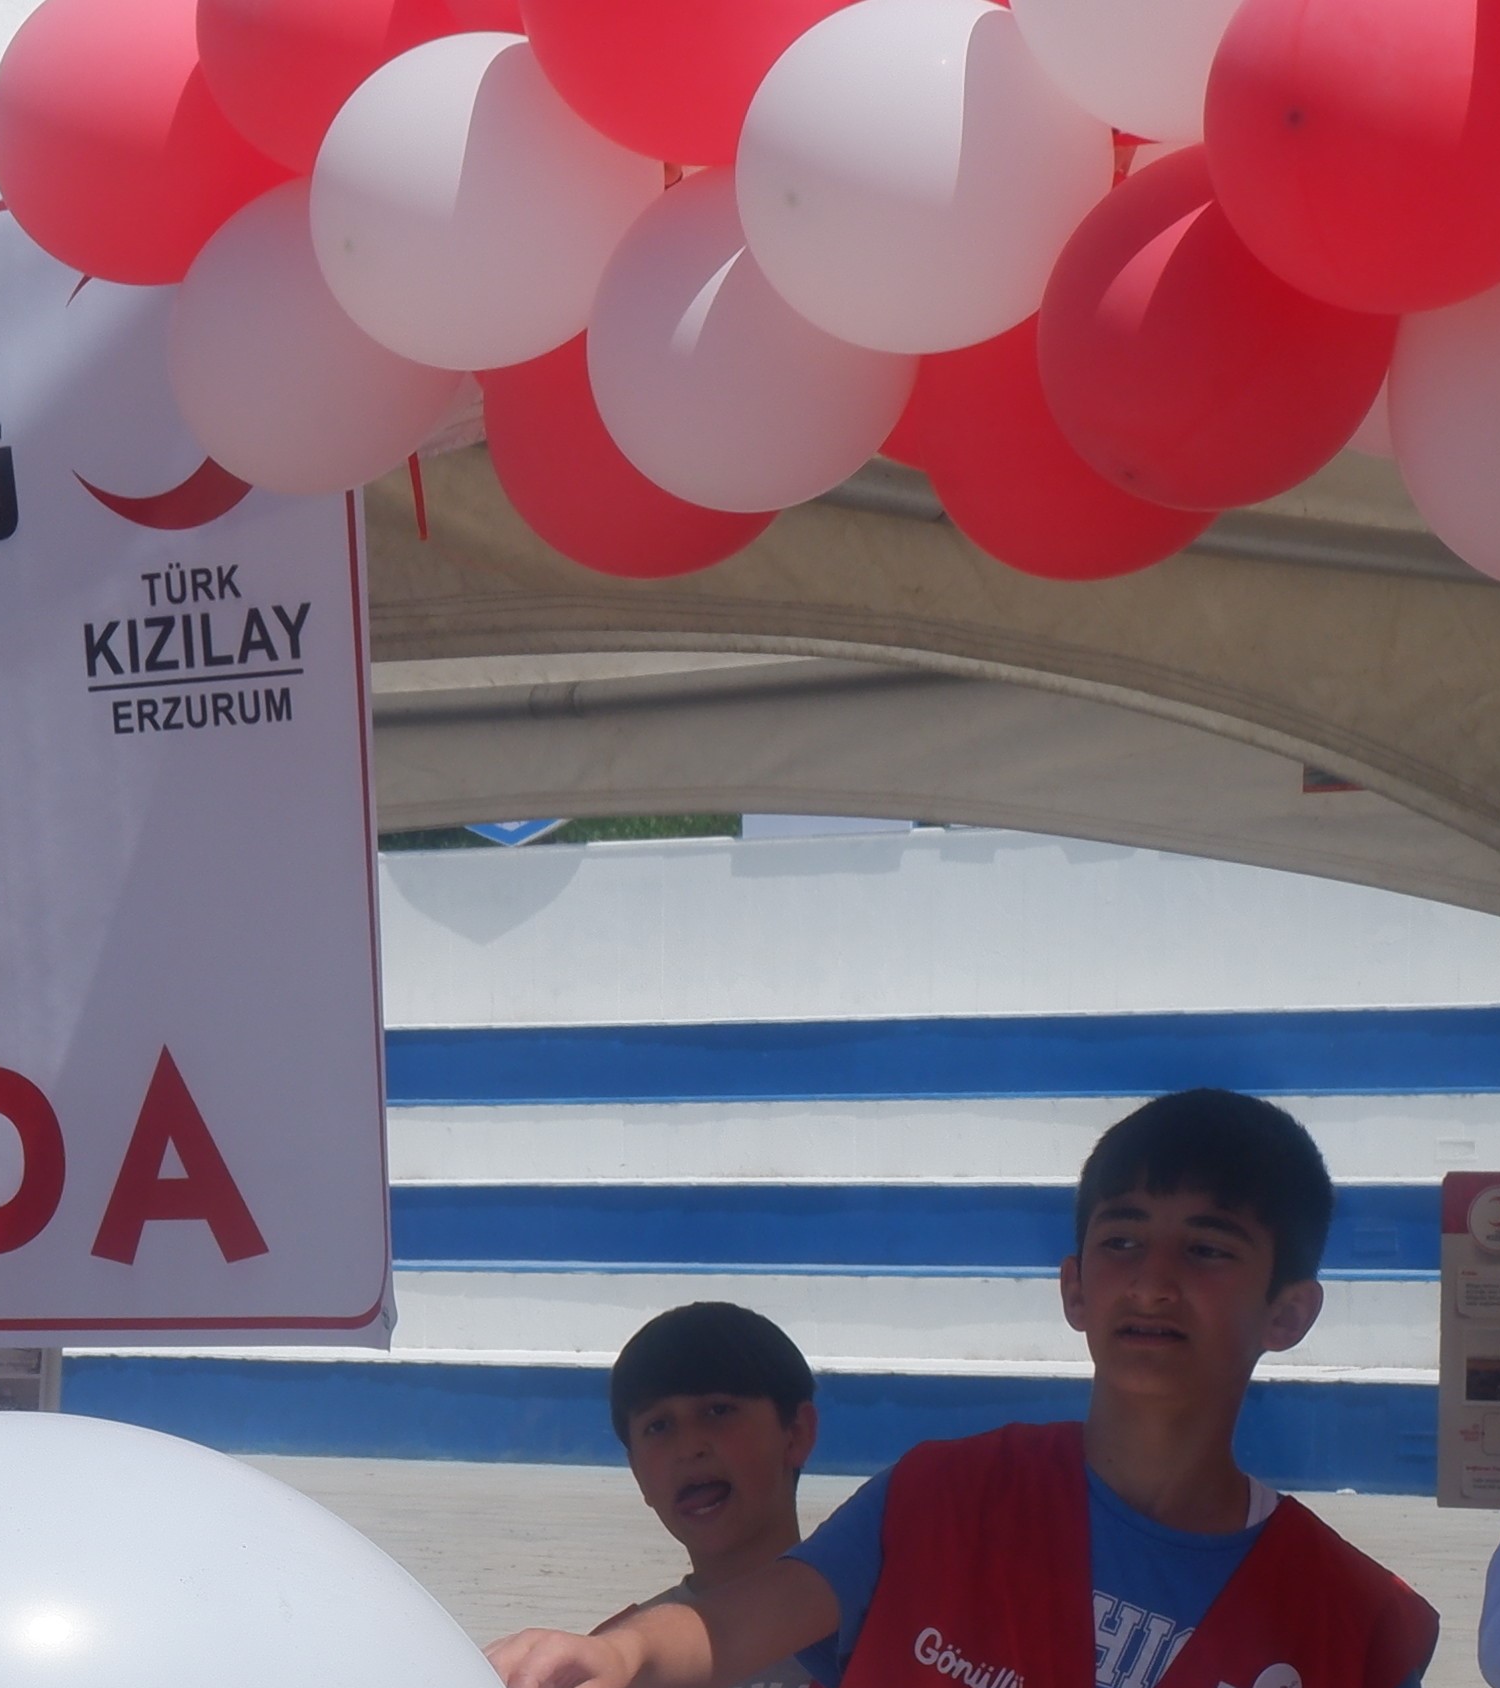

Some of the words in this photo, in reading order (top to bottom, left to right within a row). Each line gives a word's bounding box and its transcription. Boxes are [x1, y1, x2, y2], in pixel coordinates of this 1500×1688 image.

[142, 561, 241, 607] TÜRK
[83, 602, 311, 678] KIZILAY
[111, 689, 293, 736] ERZURUM
